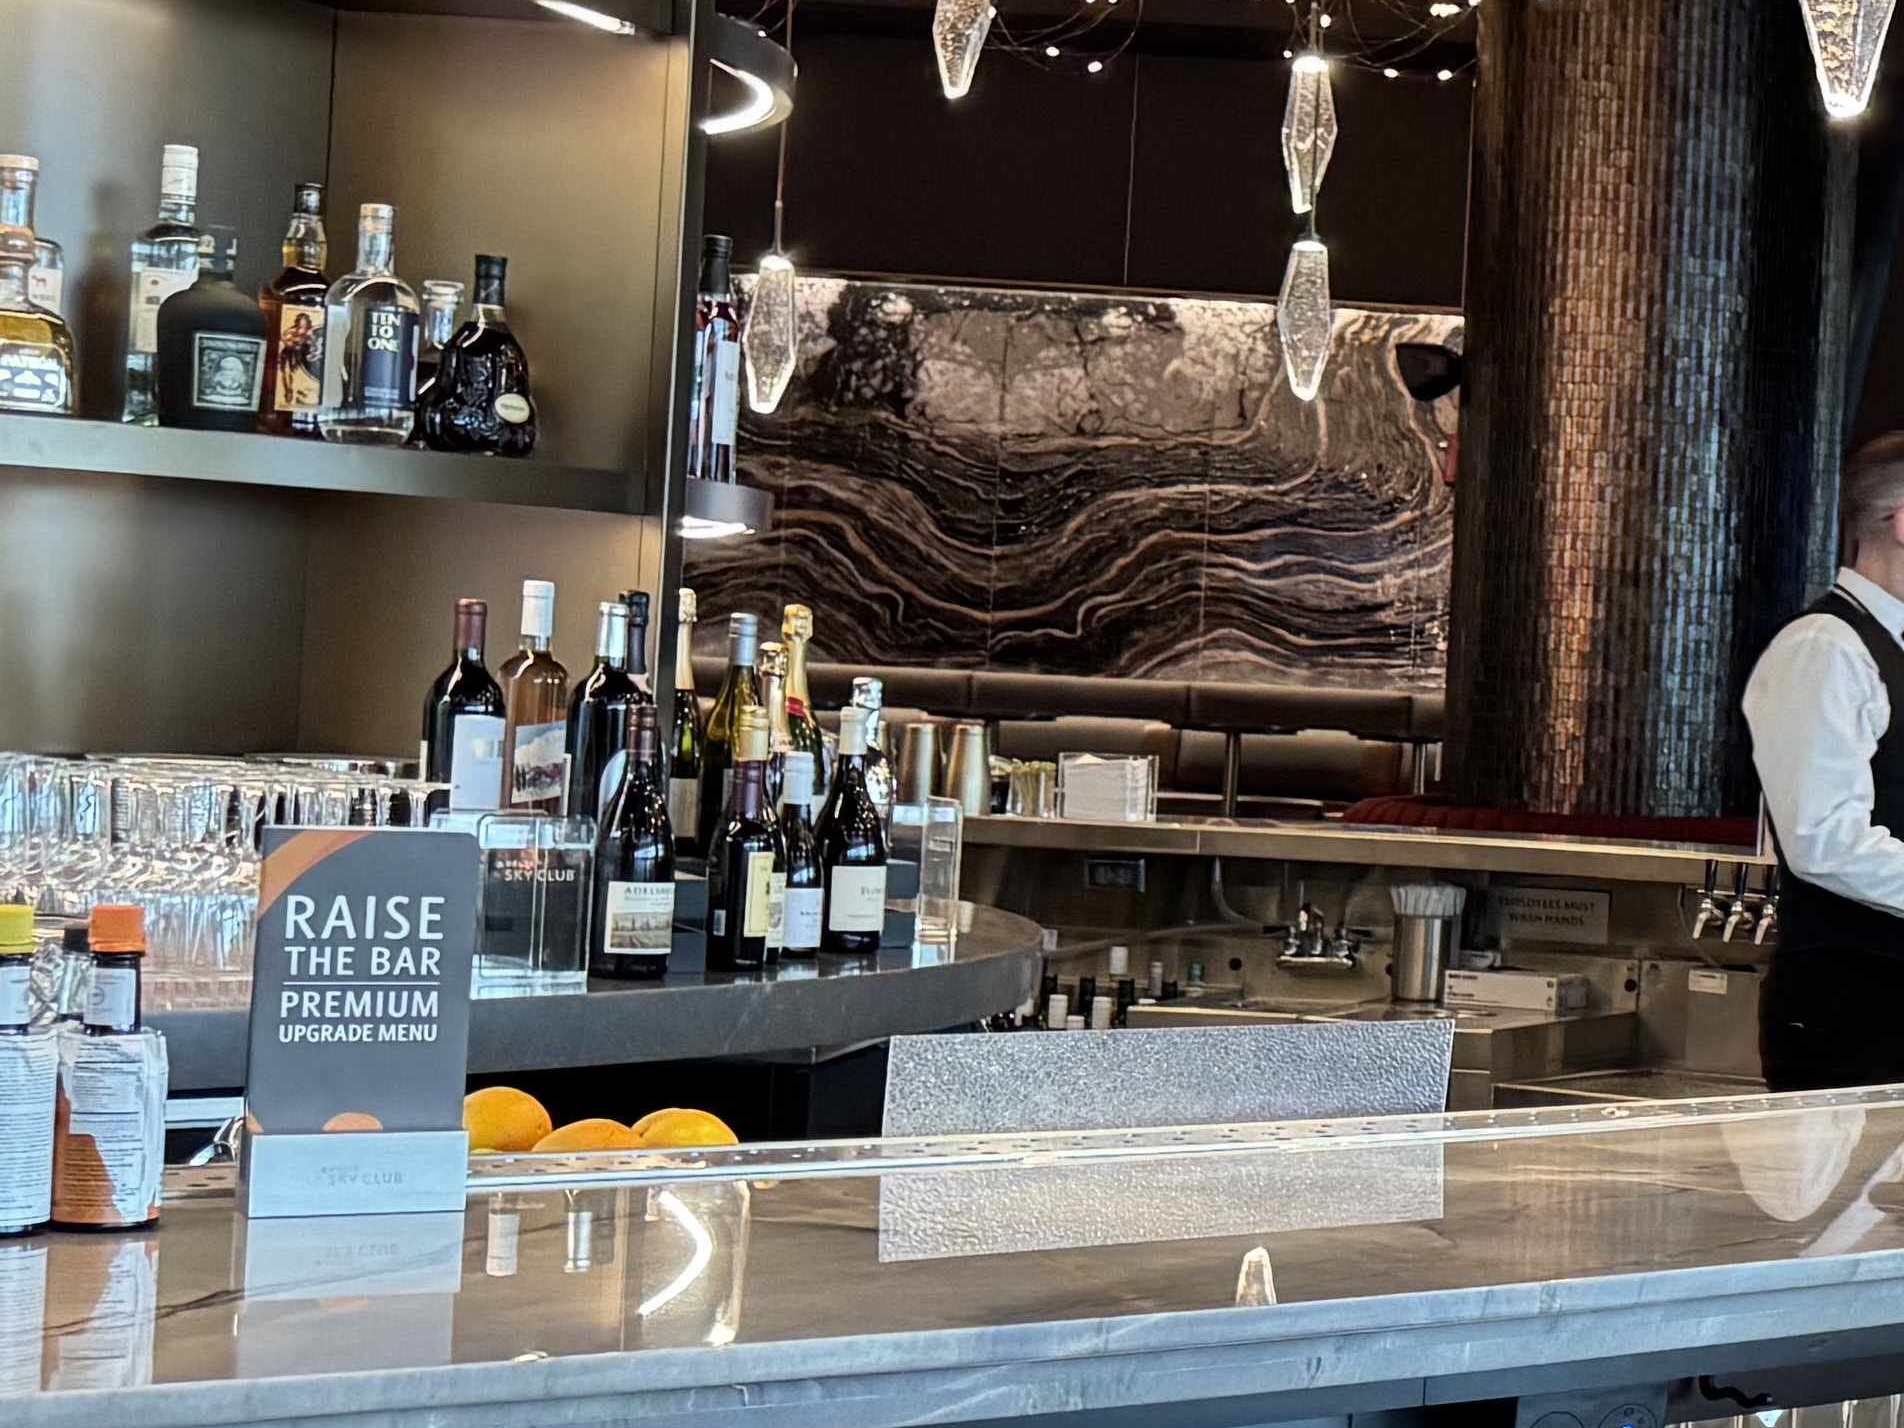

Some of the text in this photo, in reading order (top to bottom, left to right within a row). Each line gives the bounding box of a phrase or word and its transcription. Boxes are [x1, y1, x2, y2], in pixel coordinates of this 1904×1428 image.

[371, 312, 401, 327] TEN
[371, 325, 394, 339] TO
[367, 337, 399, 353] ONE
[504, 868, 575, 882] SKY CLUB
[285, 895, 445, 940] RAISE
[284, 946, 441, 976] THE BAR
[280, 990, 439, 1018] PREMIUM
[278, 1024, 438, 1043] UPGRADE MENU
[362, 1171, 403, 1185] CLUB
